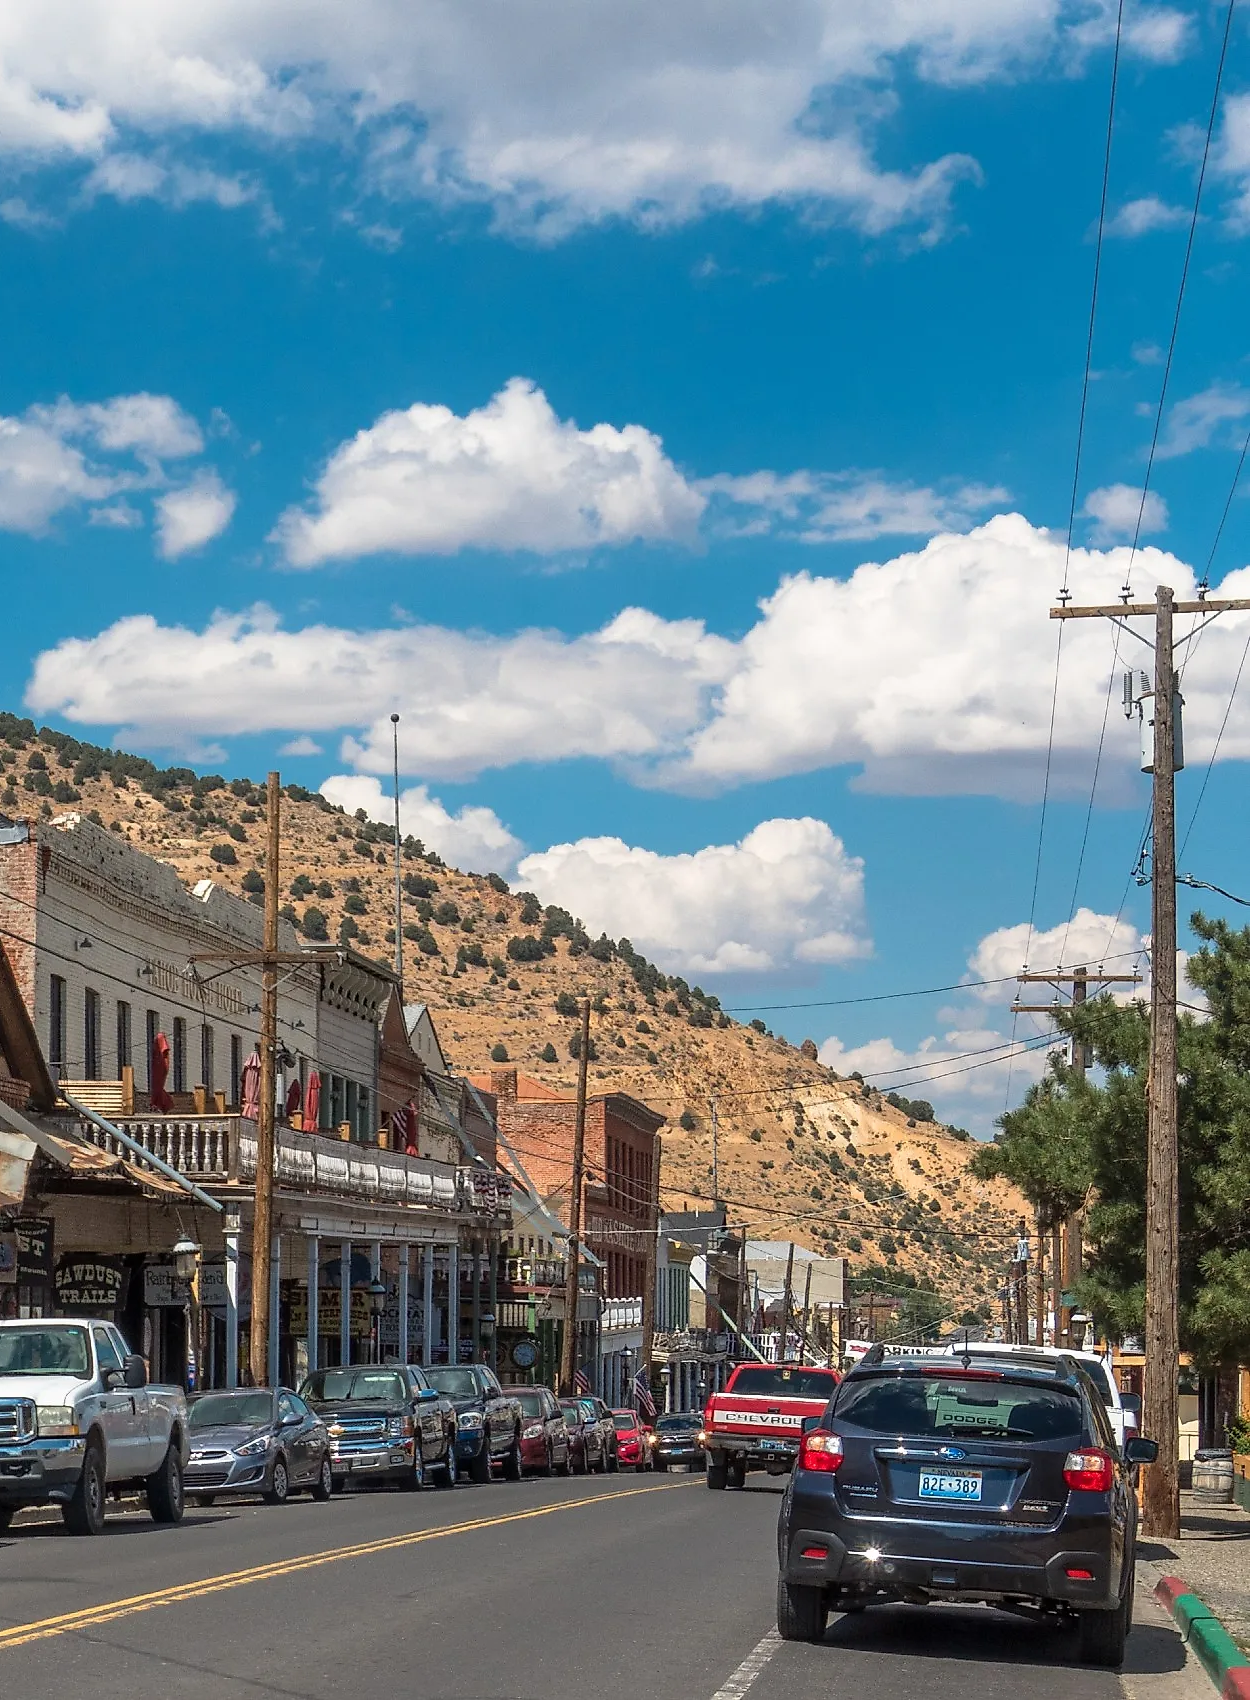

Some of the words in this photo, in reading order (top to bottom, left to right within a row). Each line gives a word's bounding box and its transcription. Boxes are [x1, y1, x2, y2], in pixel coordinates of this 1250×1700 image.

[148, 958, 179, 993] TAHOE
[55, 1264, 122, 1288] SAWDUST
[60, 1289, 117, 1304] TRAILS
[726, 1413, 801, 1425] CHEVROL
[943, 1414, 999, 1426] DODGE
[922, 1477, 946, 1492] 82E
[955, 1478, 978, 1494] 389
